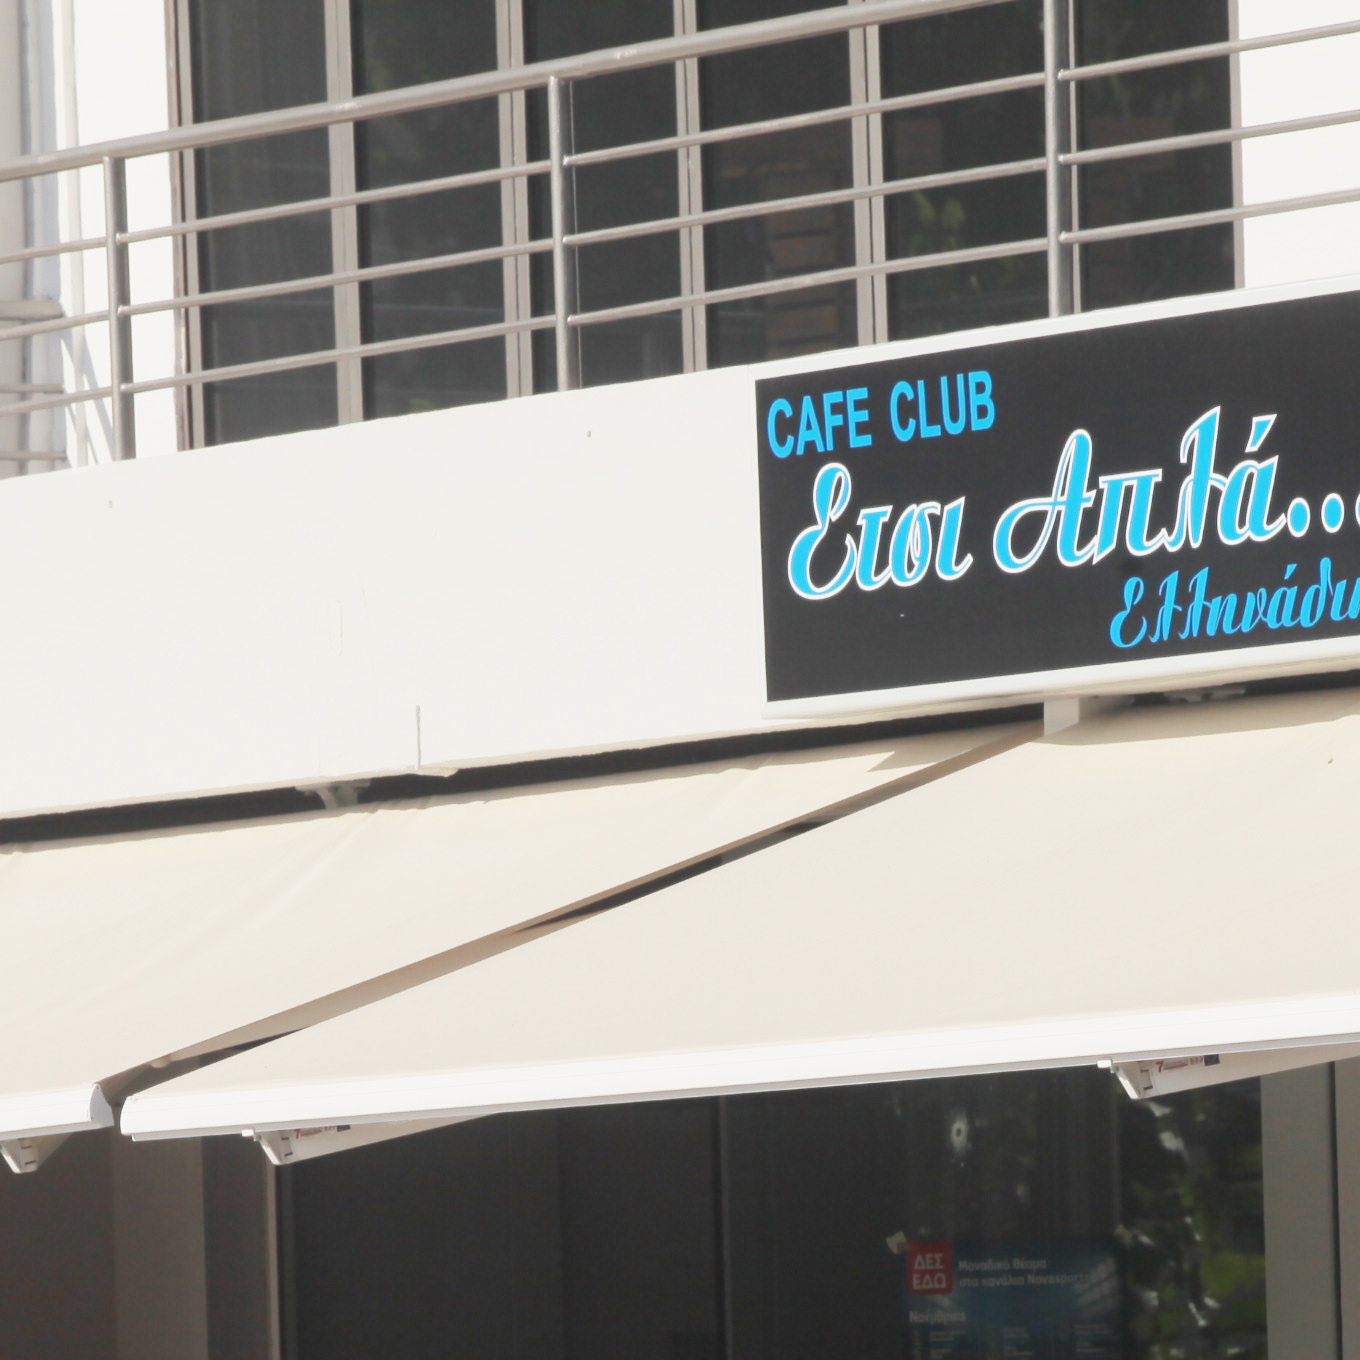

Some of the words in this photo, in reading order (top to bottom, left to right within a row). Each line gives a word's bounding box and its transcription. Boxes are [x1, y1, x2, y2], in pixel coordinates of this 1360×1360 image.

[767, 387, 872, 459] CAFE
[890, 370, 996, 442] CLUB
[913, 1254, 944, 1269] ΔΕΣ
[912, 1273, 947, 1290] ΕΔΩ
